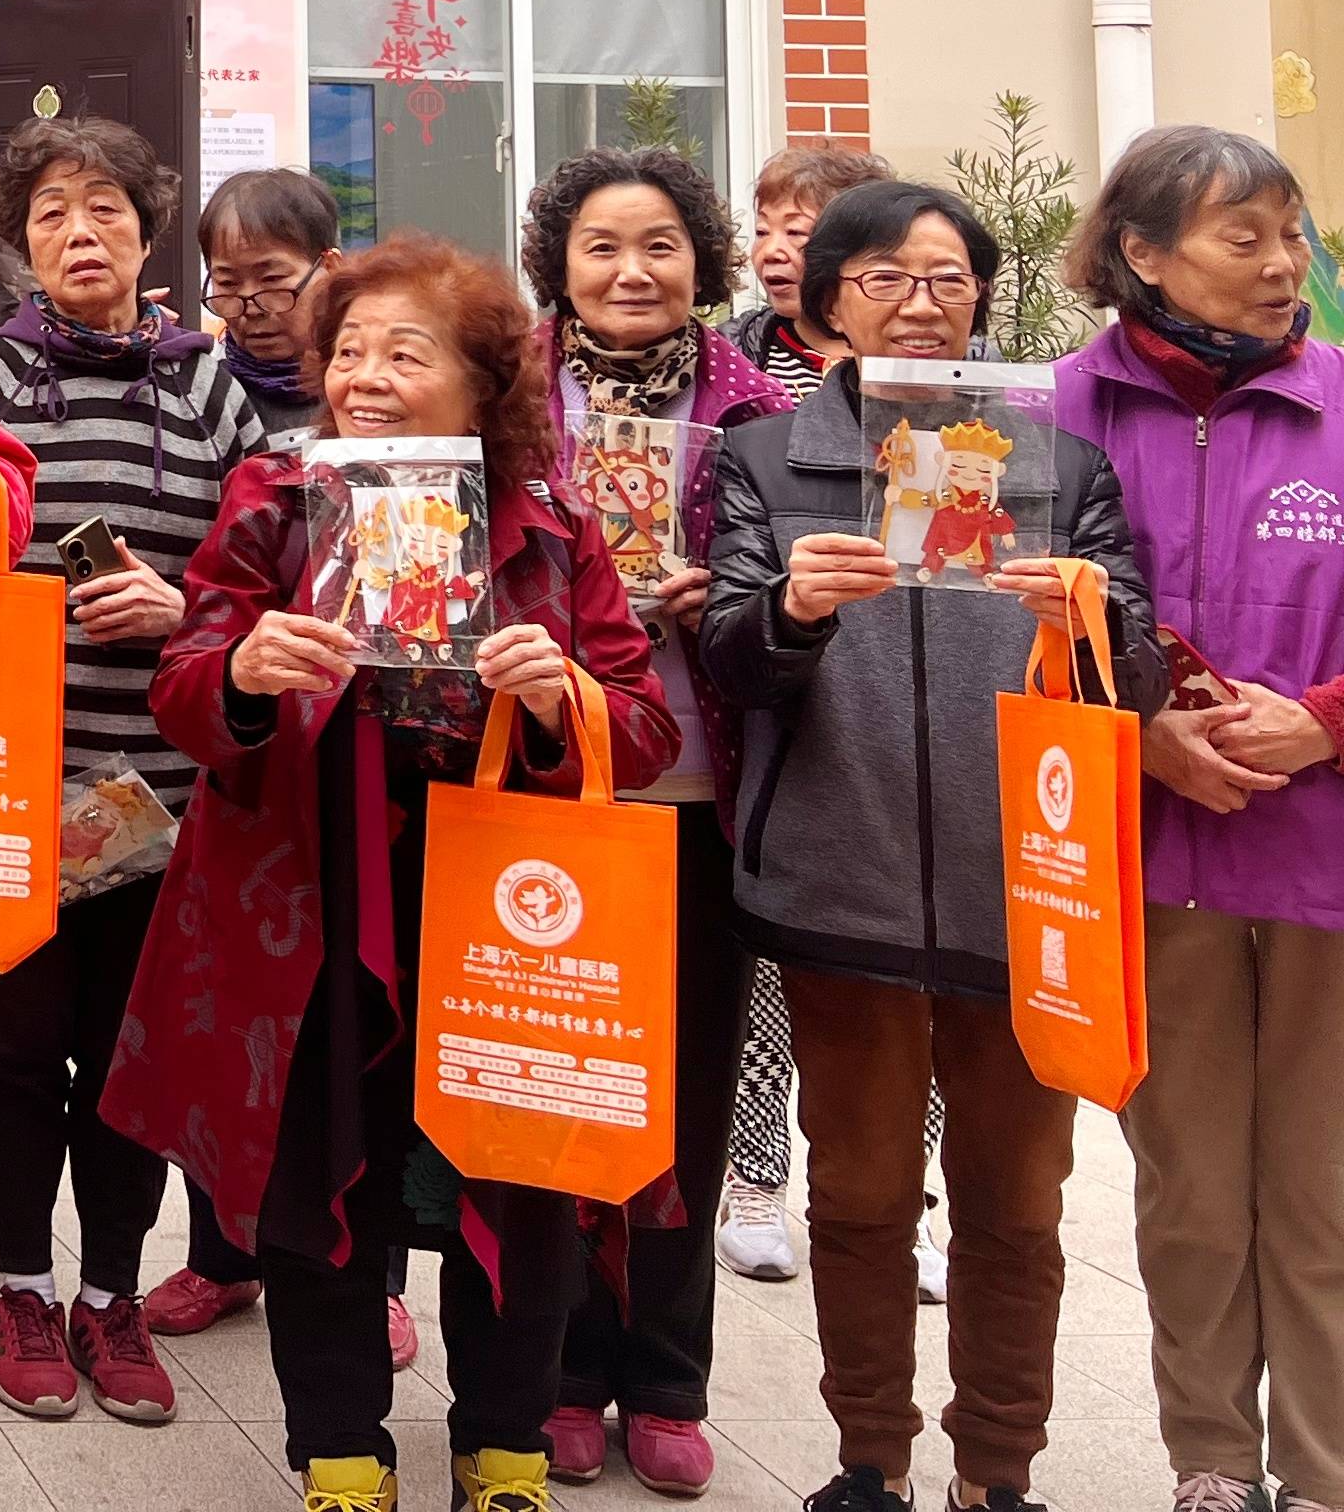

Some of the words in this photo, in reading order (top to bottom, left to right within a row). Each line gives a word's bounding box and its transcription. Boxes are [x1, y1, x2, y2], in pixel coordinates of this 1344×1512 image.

[463, 942, 620, 983] 上海六一儿童医院
[441, 994, 645, 1040] 让每个孩子都拥有健康身心
